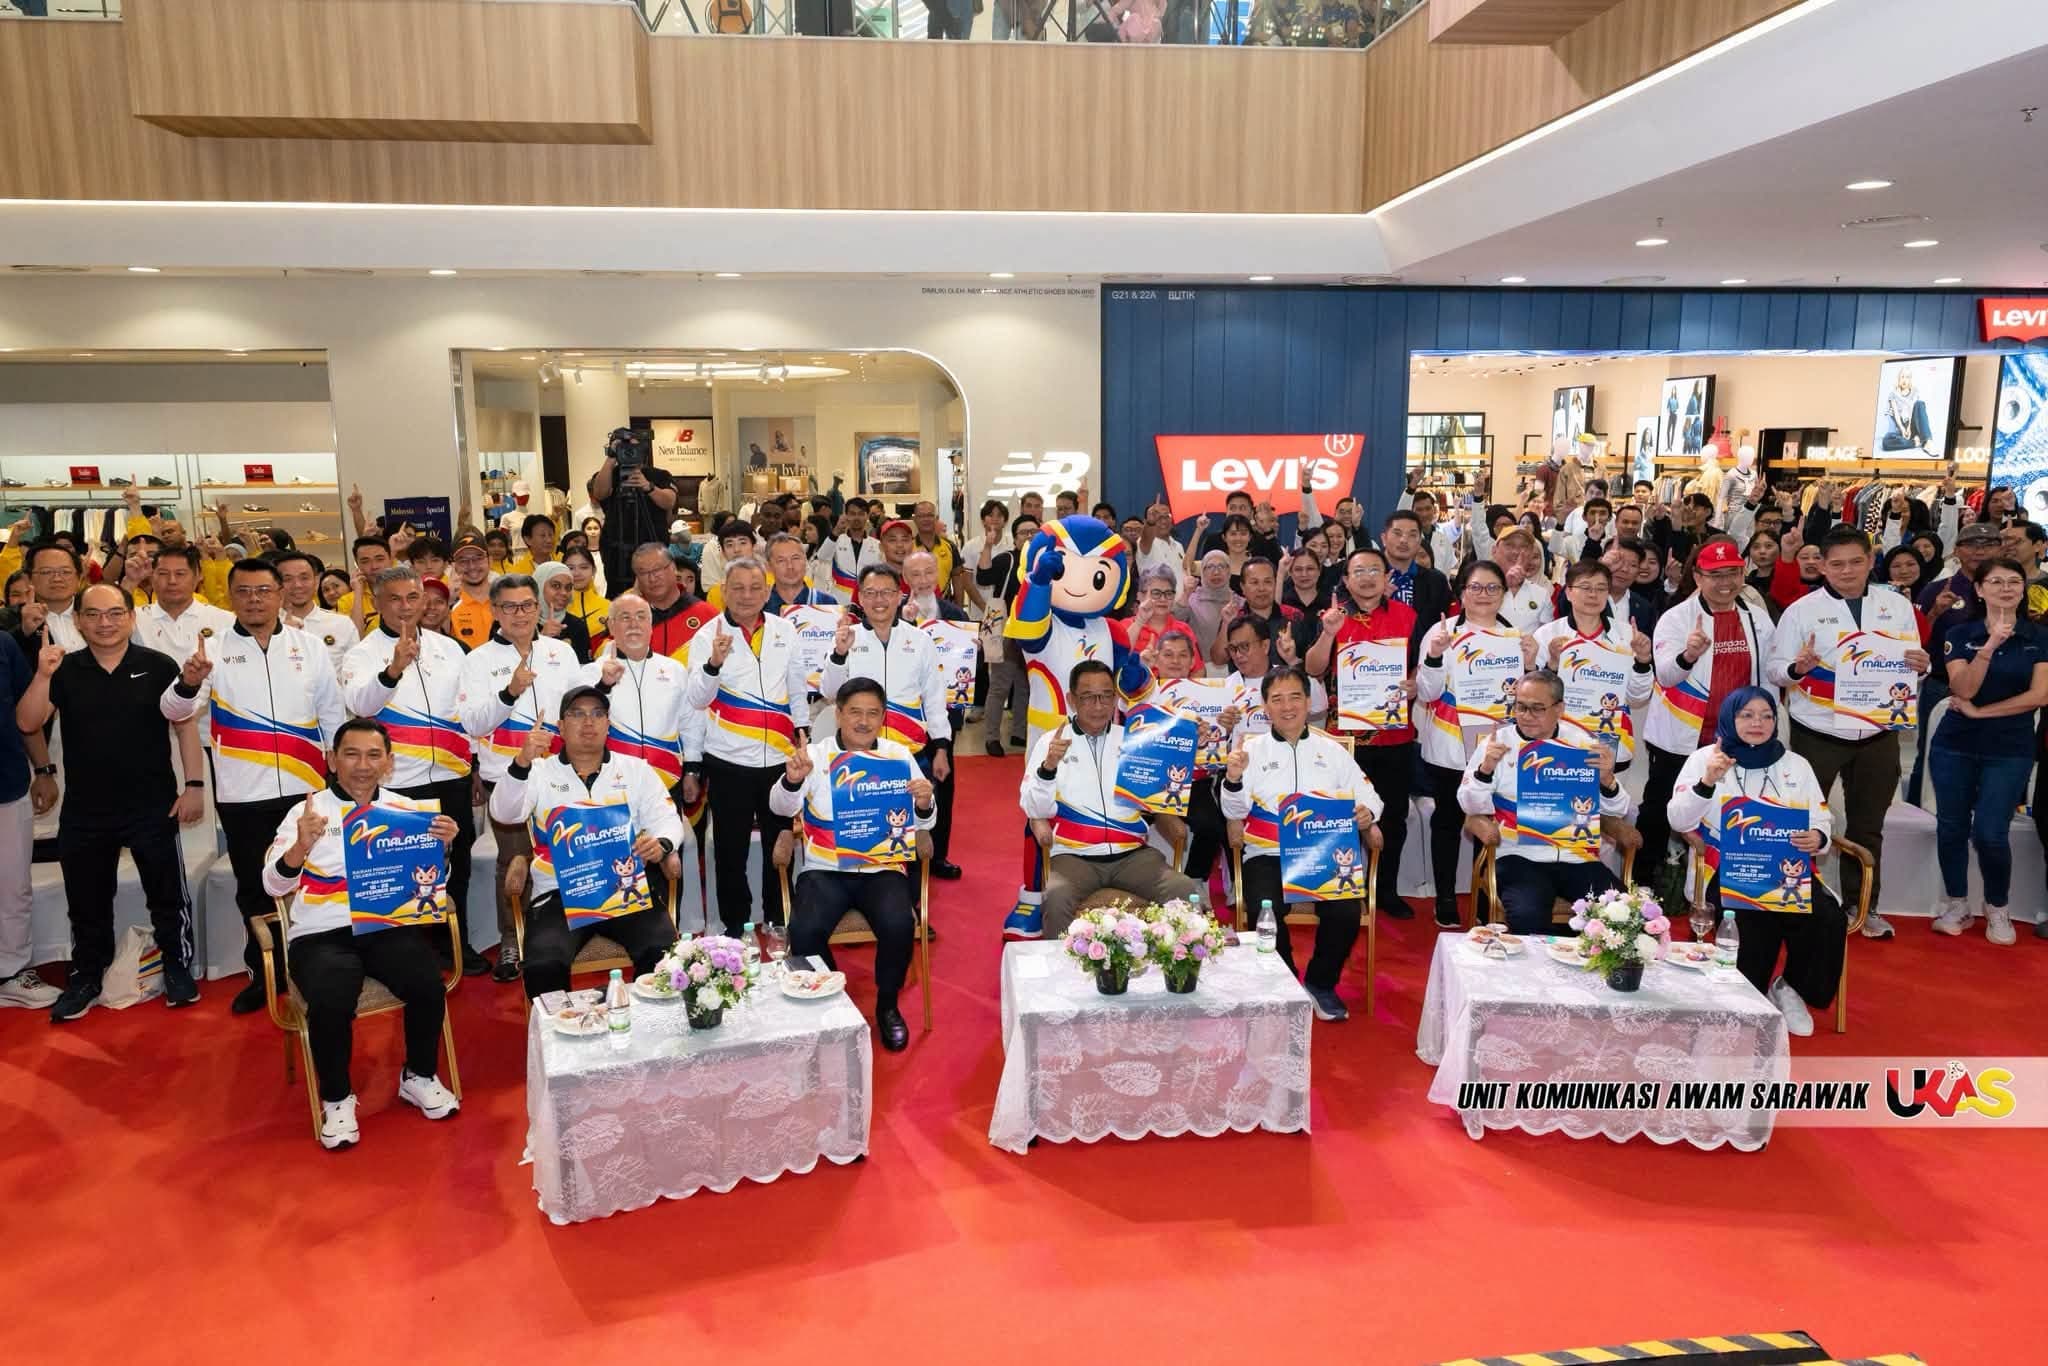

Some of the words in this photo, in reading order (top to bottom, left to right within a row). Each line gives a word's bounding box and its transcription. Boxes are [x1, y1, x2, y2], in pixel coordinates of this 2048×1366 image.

[1111, 290, 1129, 299] G21
[1132, 290, 1138, 299] &
[1140, 290, 1157, 299] 22A
[1168, 290, 1196, 300] BUTIK
[658, 446, 675, 456] New
[676, 445, 707, 456] Balance
[1807, 446, 1864, 461] RIBCAGE
[1475, 655, 1519, 666] MALAYSIA
[1360, 664, 1403, 672] MALAYSIA
[1580, 667, 1624, 680] MALAYSIA
[1543, 767, 1595, 777] MALAYSIA
[857, 779, 907, 792] MALAYSIA
[1303, 818, 1353, 829] MALAYSIA
